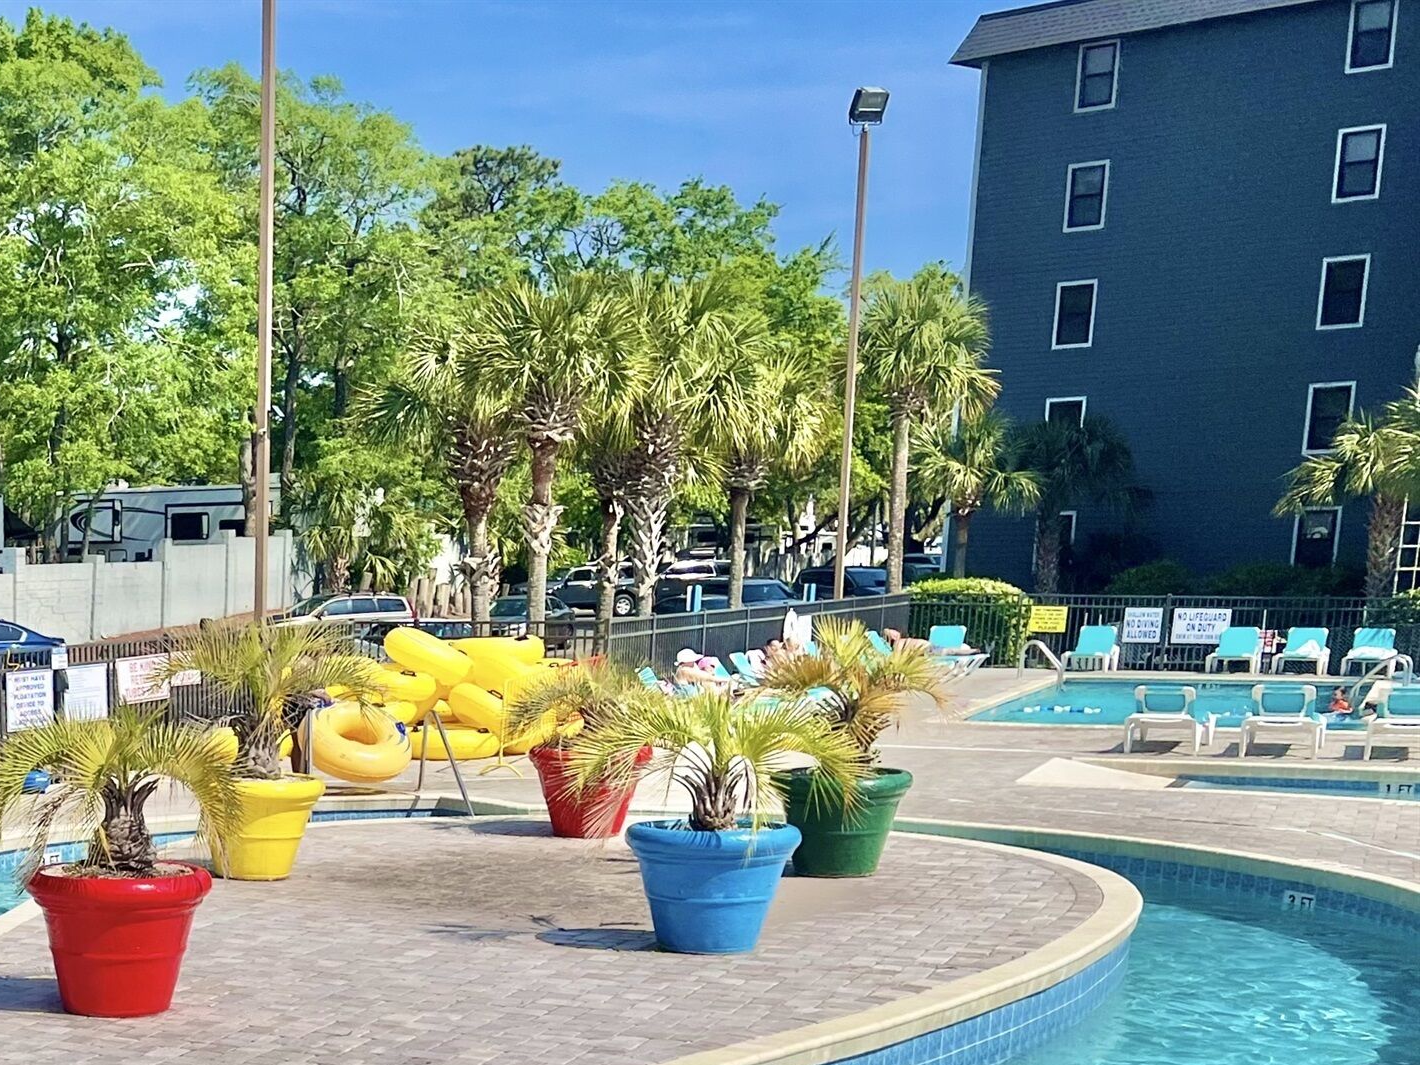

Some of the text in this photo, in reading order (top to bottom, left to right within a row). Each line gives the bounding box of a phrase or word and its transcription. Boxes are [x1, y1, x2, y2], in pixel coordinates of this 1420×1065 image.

[1177, 612, 1227, 621] NO LIFEGUARD
[1126, 619, 1159, 629] NO DIVING
[1186, 623, 1216, 632] ON DUTY
[1126, 630, 1157, 639] ALLOWED
[1398, 784, 1413, 794] FT
[1300, 896, 1314, 909] FT
